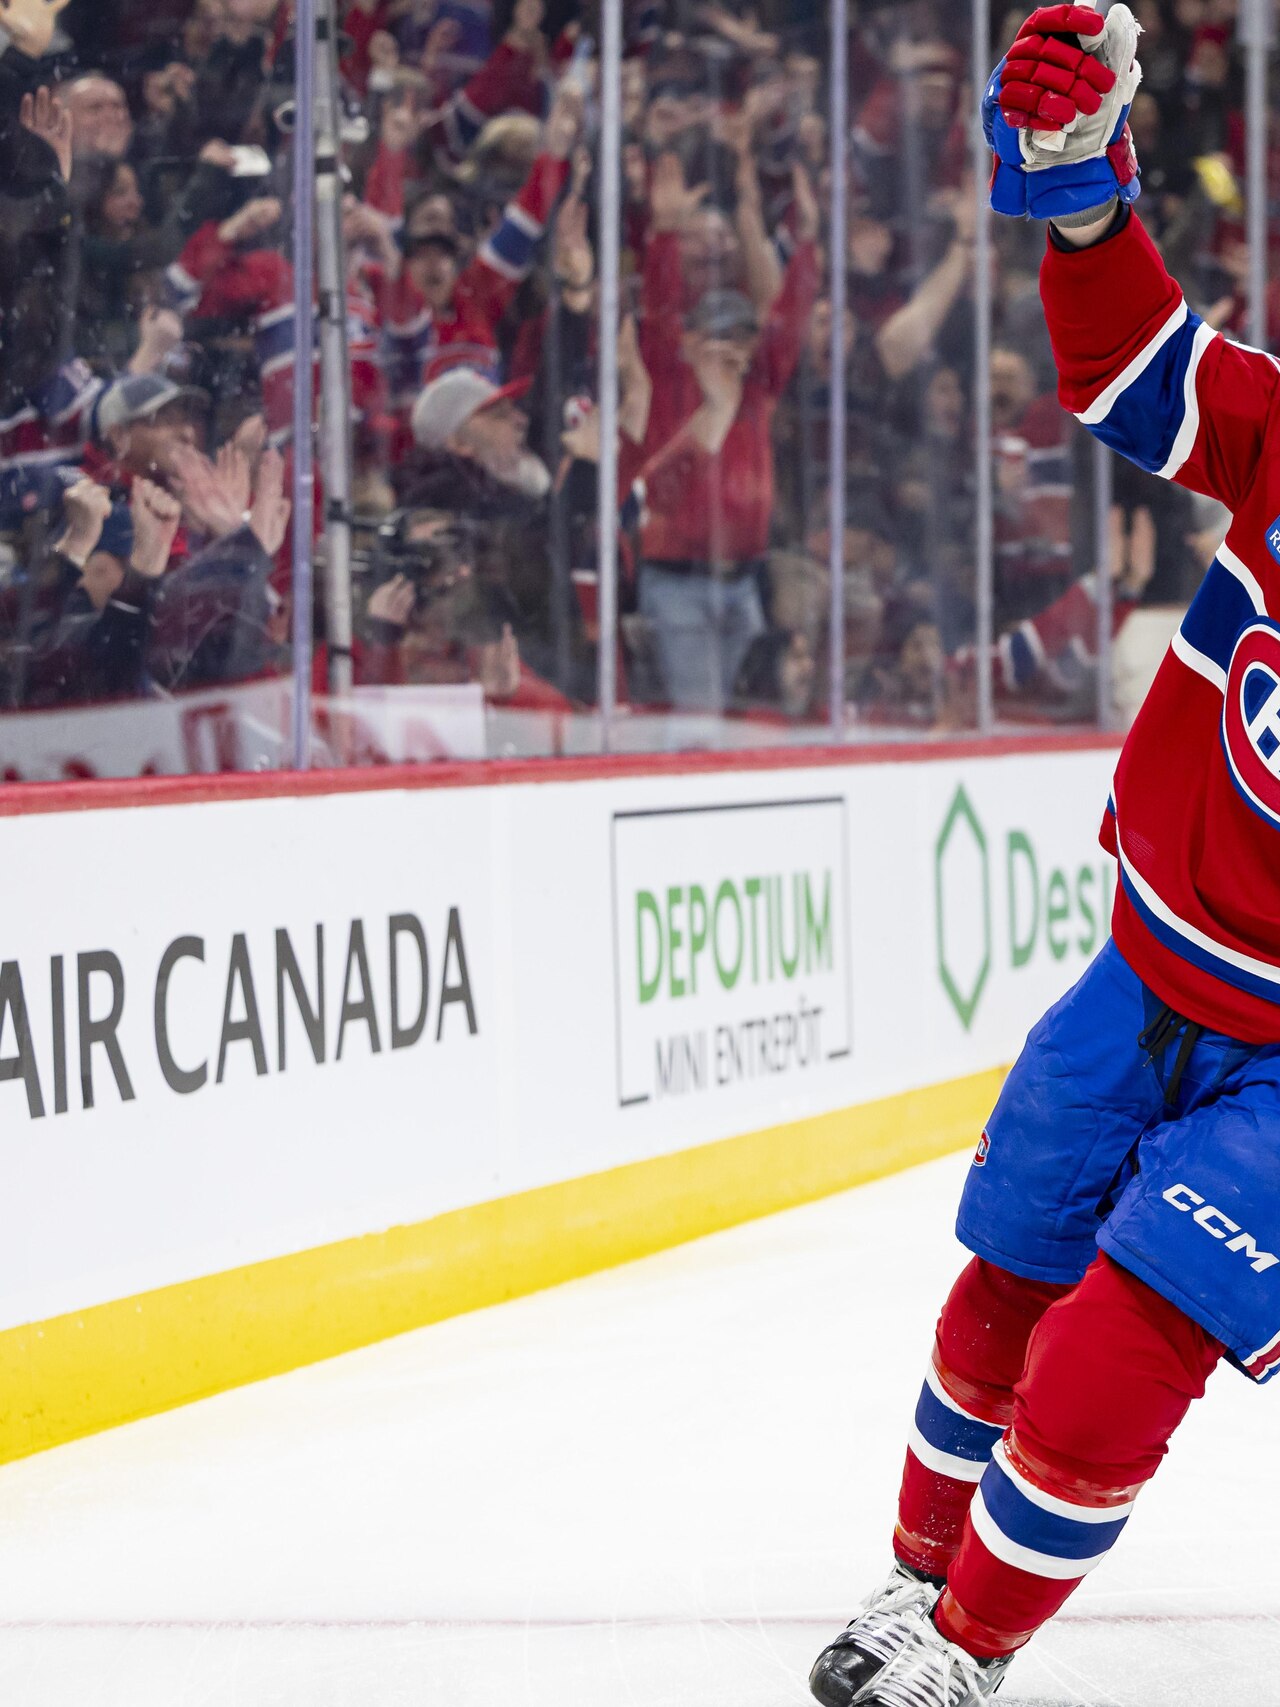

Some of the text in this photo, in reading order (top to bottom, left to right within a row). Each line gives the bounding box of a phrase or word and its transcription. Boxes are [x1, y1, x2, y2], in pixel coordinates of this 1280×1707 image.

[636, 868, 832, 1005] DEPOTIUM
[0, 906, 479, 1119] AIR CANADA
[1162, 1183, 1280, 1273] CCM
